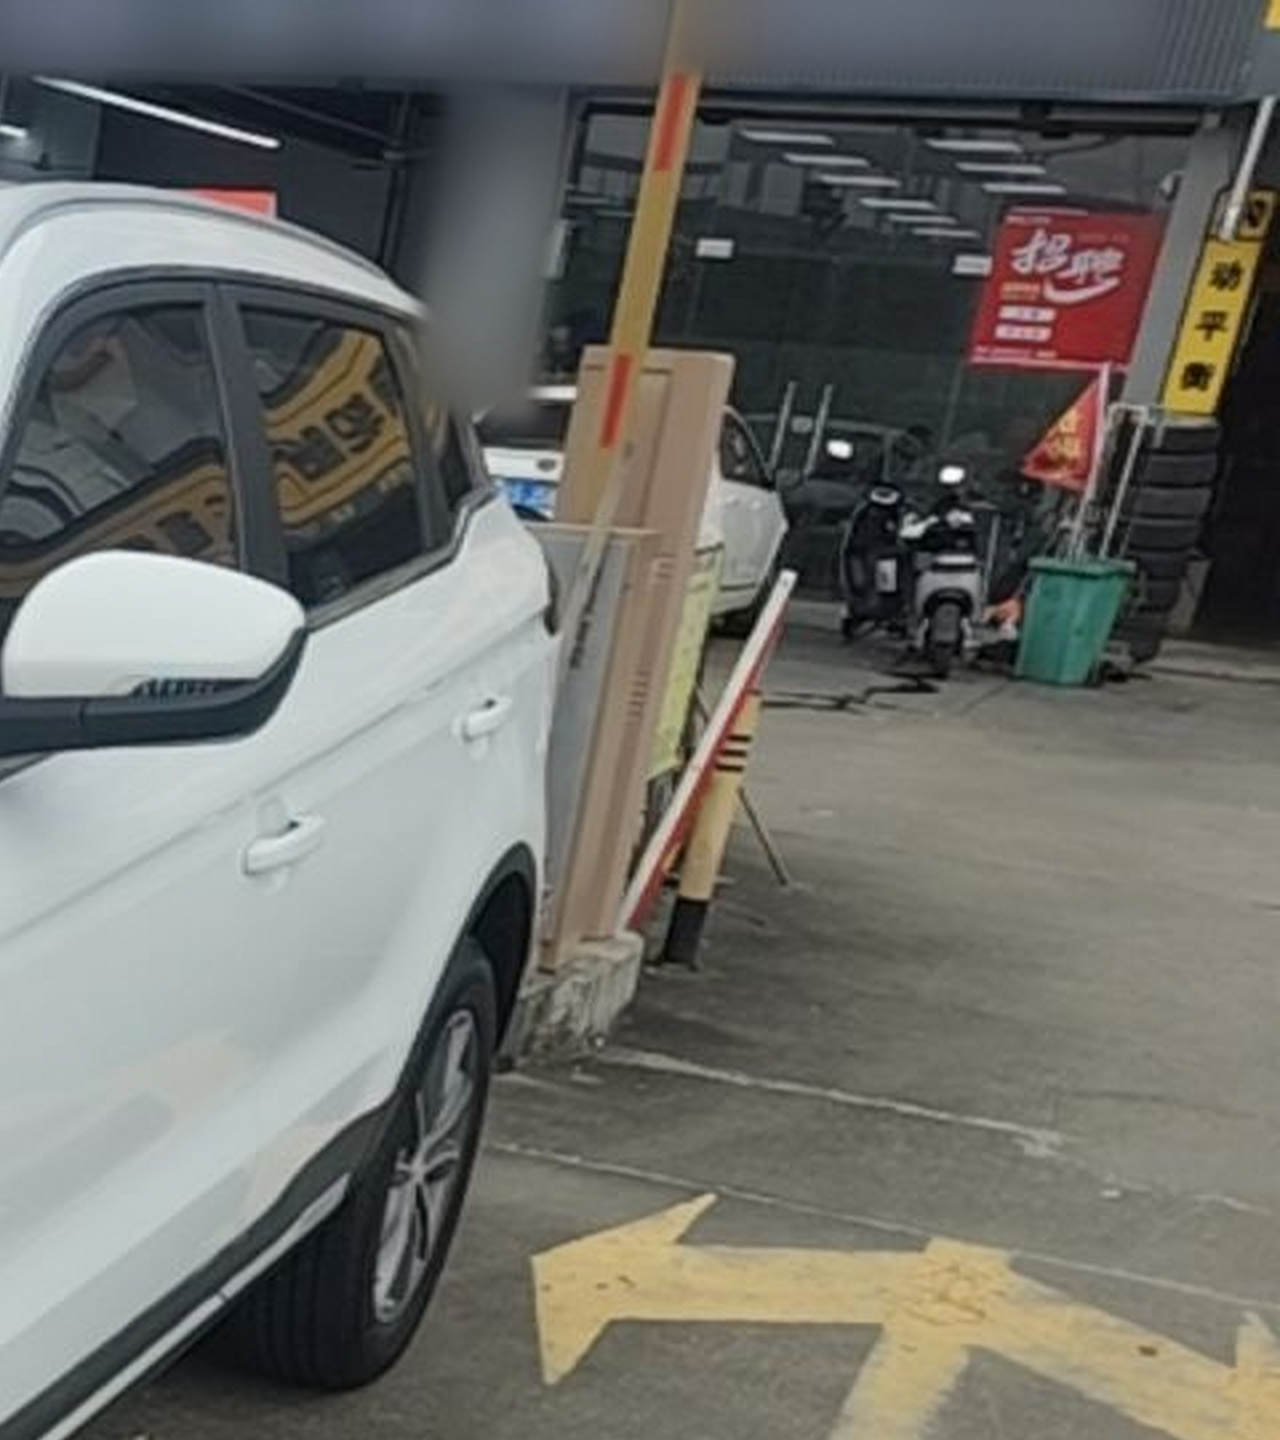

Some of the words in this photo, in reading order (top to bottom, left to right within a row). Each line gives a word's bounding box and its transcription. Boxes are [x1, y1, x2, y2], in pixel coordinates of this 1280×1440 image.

[1011, 228, 1125, 303] 招聘
[1180, 261, 1243, 391] 动平衡
